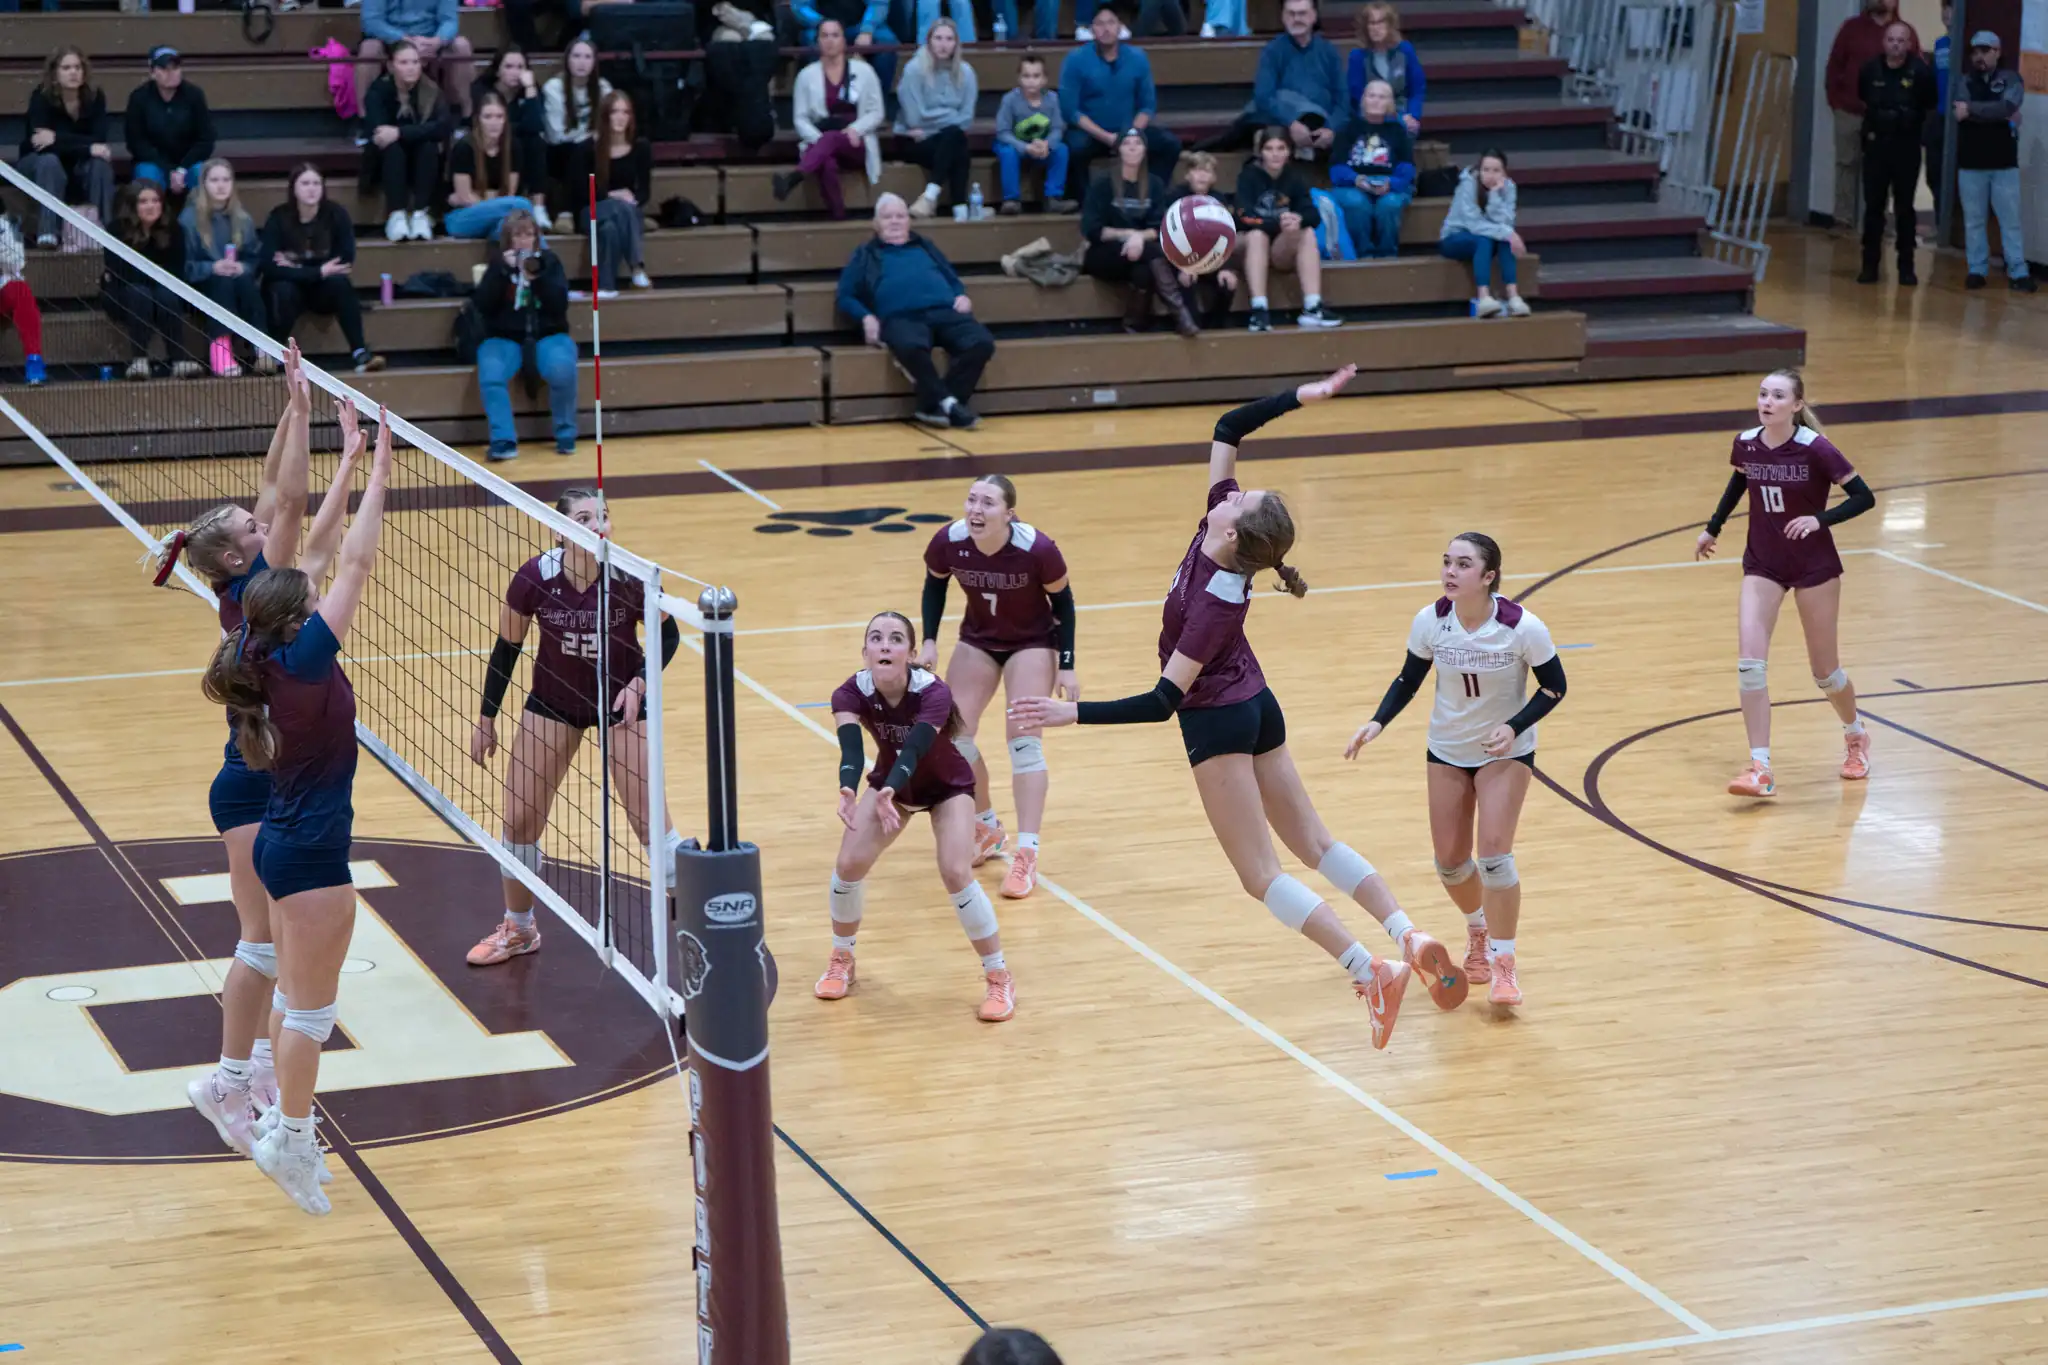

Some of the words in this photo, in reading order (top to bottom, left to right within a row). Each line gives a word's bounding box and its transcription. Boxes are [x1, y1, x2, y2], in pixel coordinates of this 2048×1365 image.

[1760, 486, 1785, 512] 10
[981, 592, 998, 616] 7
[561, 631, 598, 659] 22
[1461, 673, 1480, 697] 11
